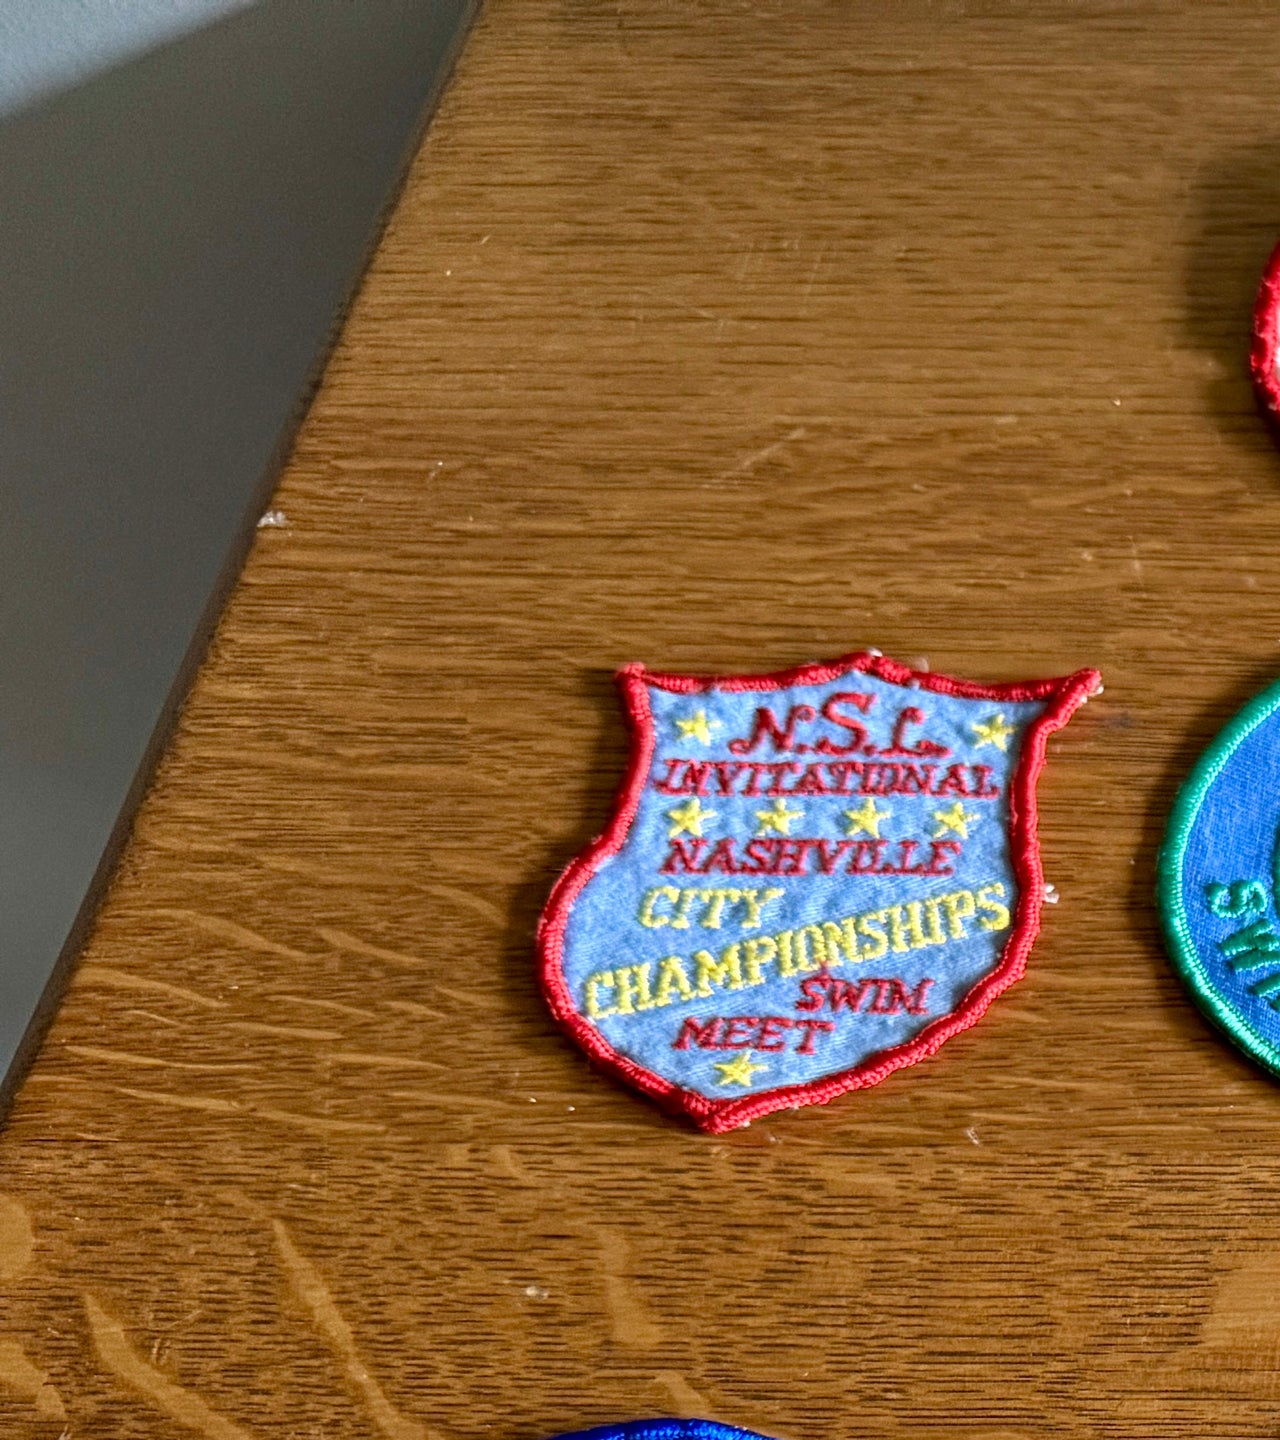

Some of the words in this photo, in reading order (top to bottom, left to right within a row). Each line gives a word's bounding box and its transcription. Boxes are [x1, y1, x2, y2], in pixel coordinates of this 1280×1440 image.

[652, 758, 1001, 799] INVITATIONAL
[660, 837, 964, 876] NASHVILLE
[637, 885, 786, 929] CITY
[582, 882, 1013, 1021] CHAMPIONSHIPS
[796, 977, 938, 1017] SWIM
[671, 1015, 836, 1056] MEET
